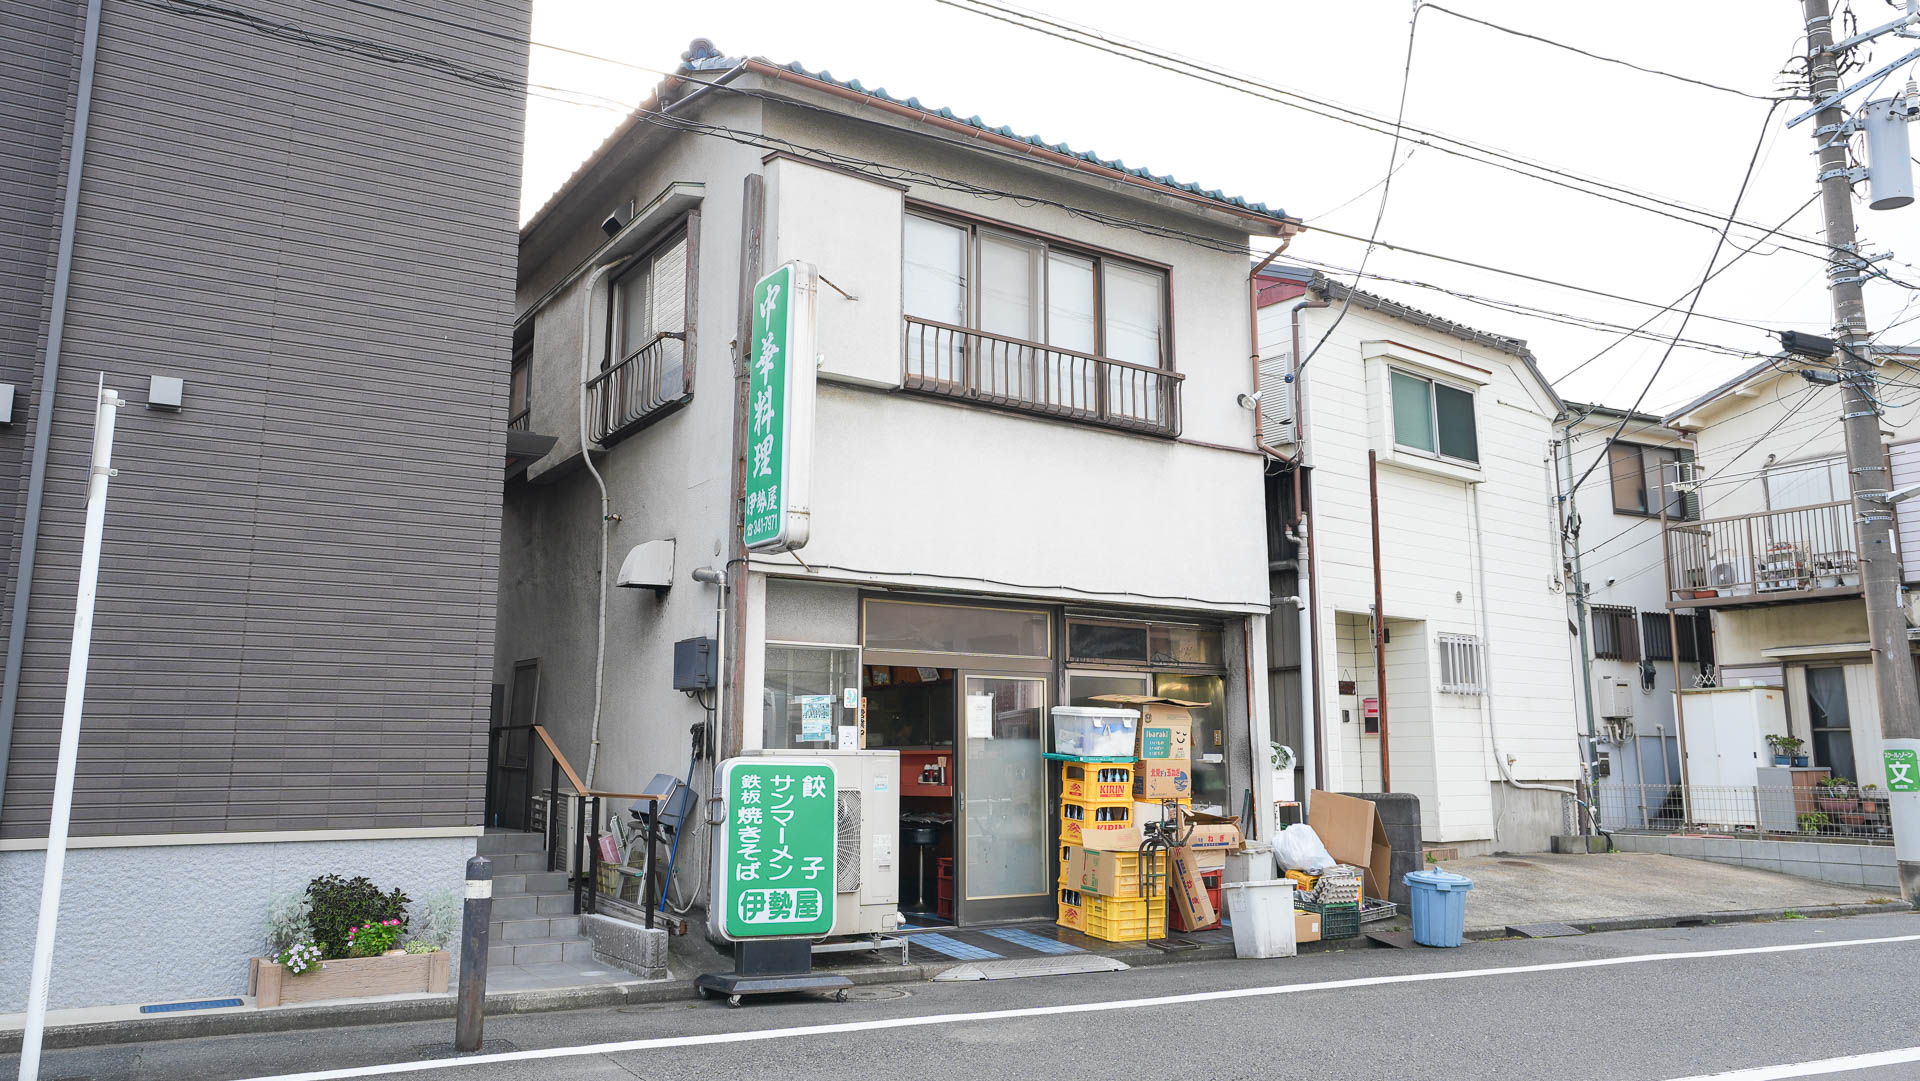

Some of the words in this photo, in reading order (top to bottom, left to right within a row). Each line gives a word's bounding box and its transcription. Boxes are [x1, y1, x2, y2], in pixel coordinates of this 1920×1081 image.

[753, 284, 781, 479] 中華料理
[747, 485, 778, 516] 伊勢屋
[753, 513, 778, 535] 341-7971
[1888, 761, 1913, 784] 文
[1099, 784, 1125, 794] KIRIN
[736, 774, 763, 881] 鉄板焼きそば
[769, 774, 795, 881] サンマーメン
[800, 775, 827, 880] 餃子
[740, 890, 819, 921] 伊勢屋
